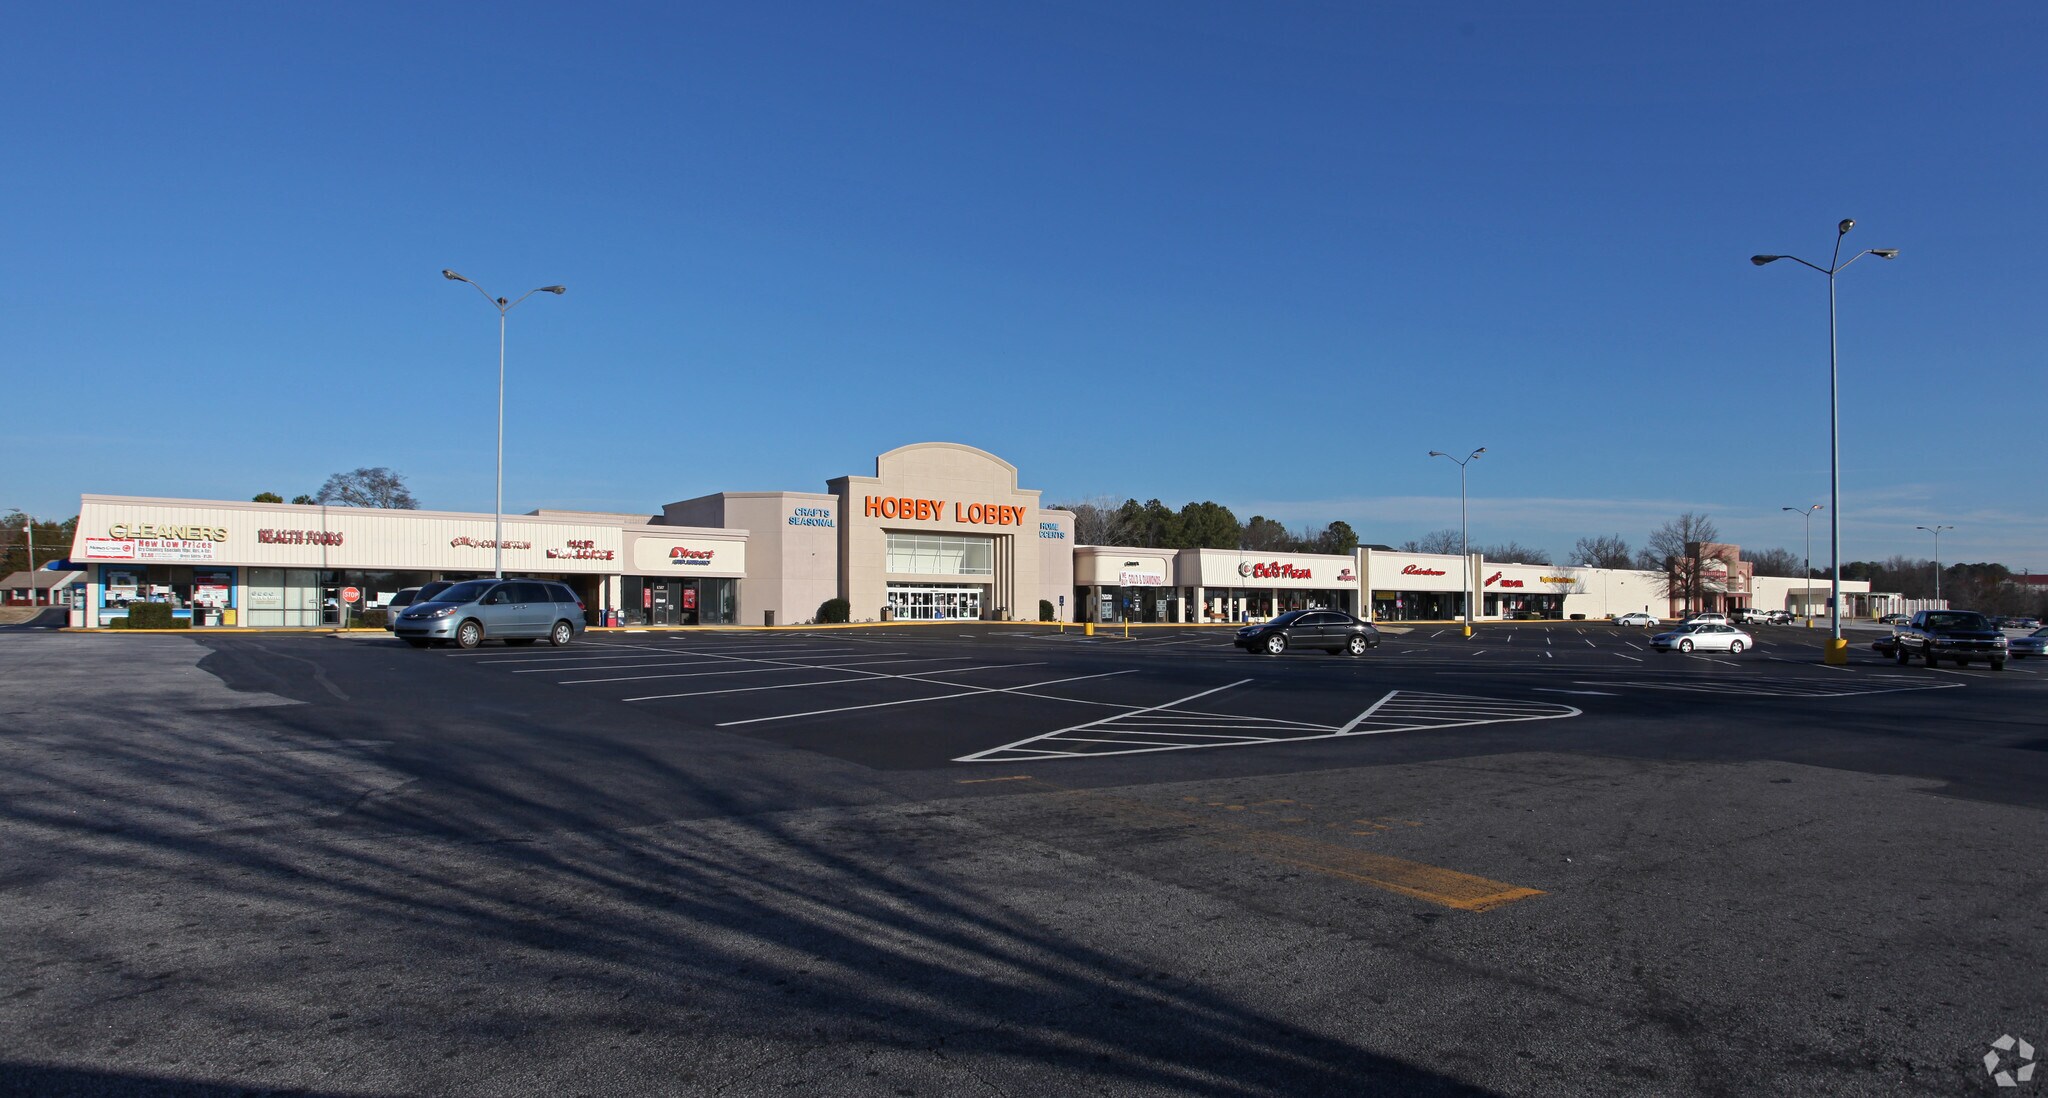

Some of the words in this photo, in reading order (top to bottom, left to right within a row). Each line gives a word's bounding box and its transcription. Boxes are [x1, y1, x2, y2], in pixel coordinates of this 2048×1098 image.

[794, 508, 830, 518] CRAFTS
[865, 496, 945, 521] HOBBY
[956, 502, 1026, 526] LOBBY
[788, 516, 835, 528] SEASONAL
[1040, 522, 1059, 531] HOME
[109, 523, 229, 542] CLEANERS
[258, 529, 304, 544] HEALTH
[306, 531, 344, 546] FOODS
[1039, 531, 1065, 539] CCENTS
[161, 540, 179, 548] Low
[182, 541, 212, 549] Prices
[567, 540, 594, 549] HAIR
[669, 547, 715, 559] Direct
[344, 591, 359, 599] STOP
